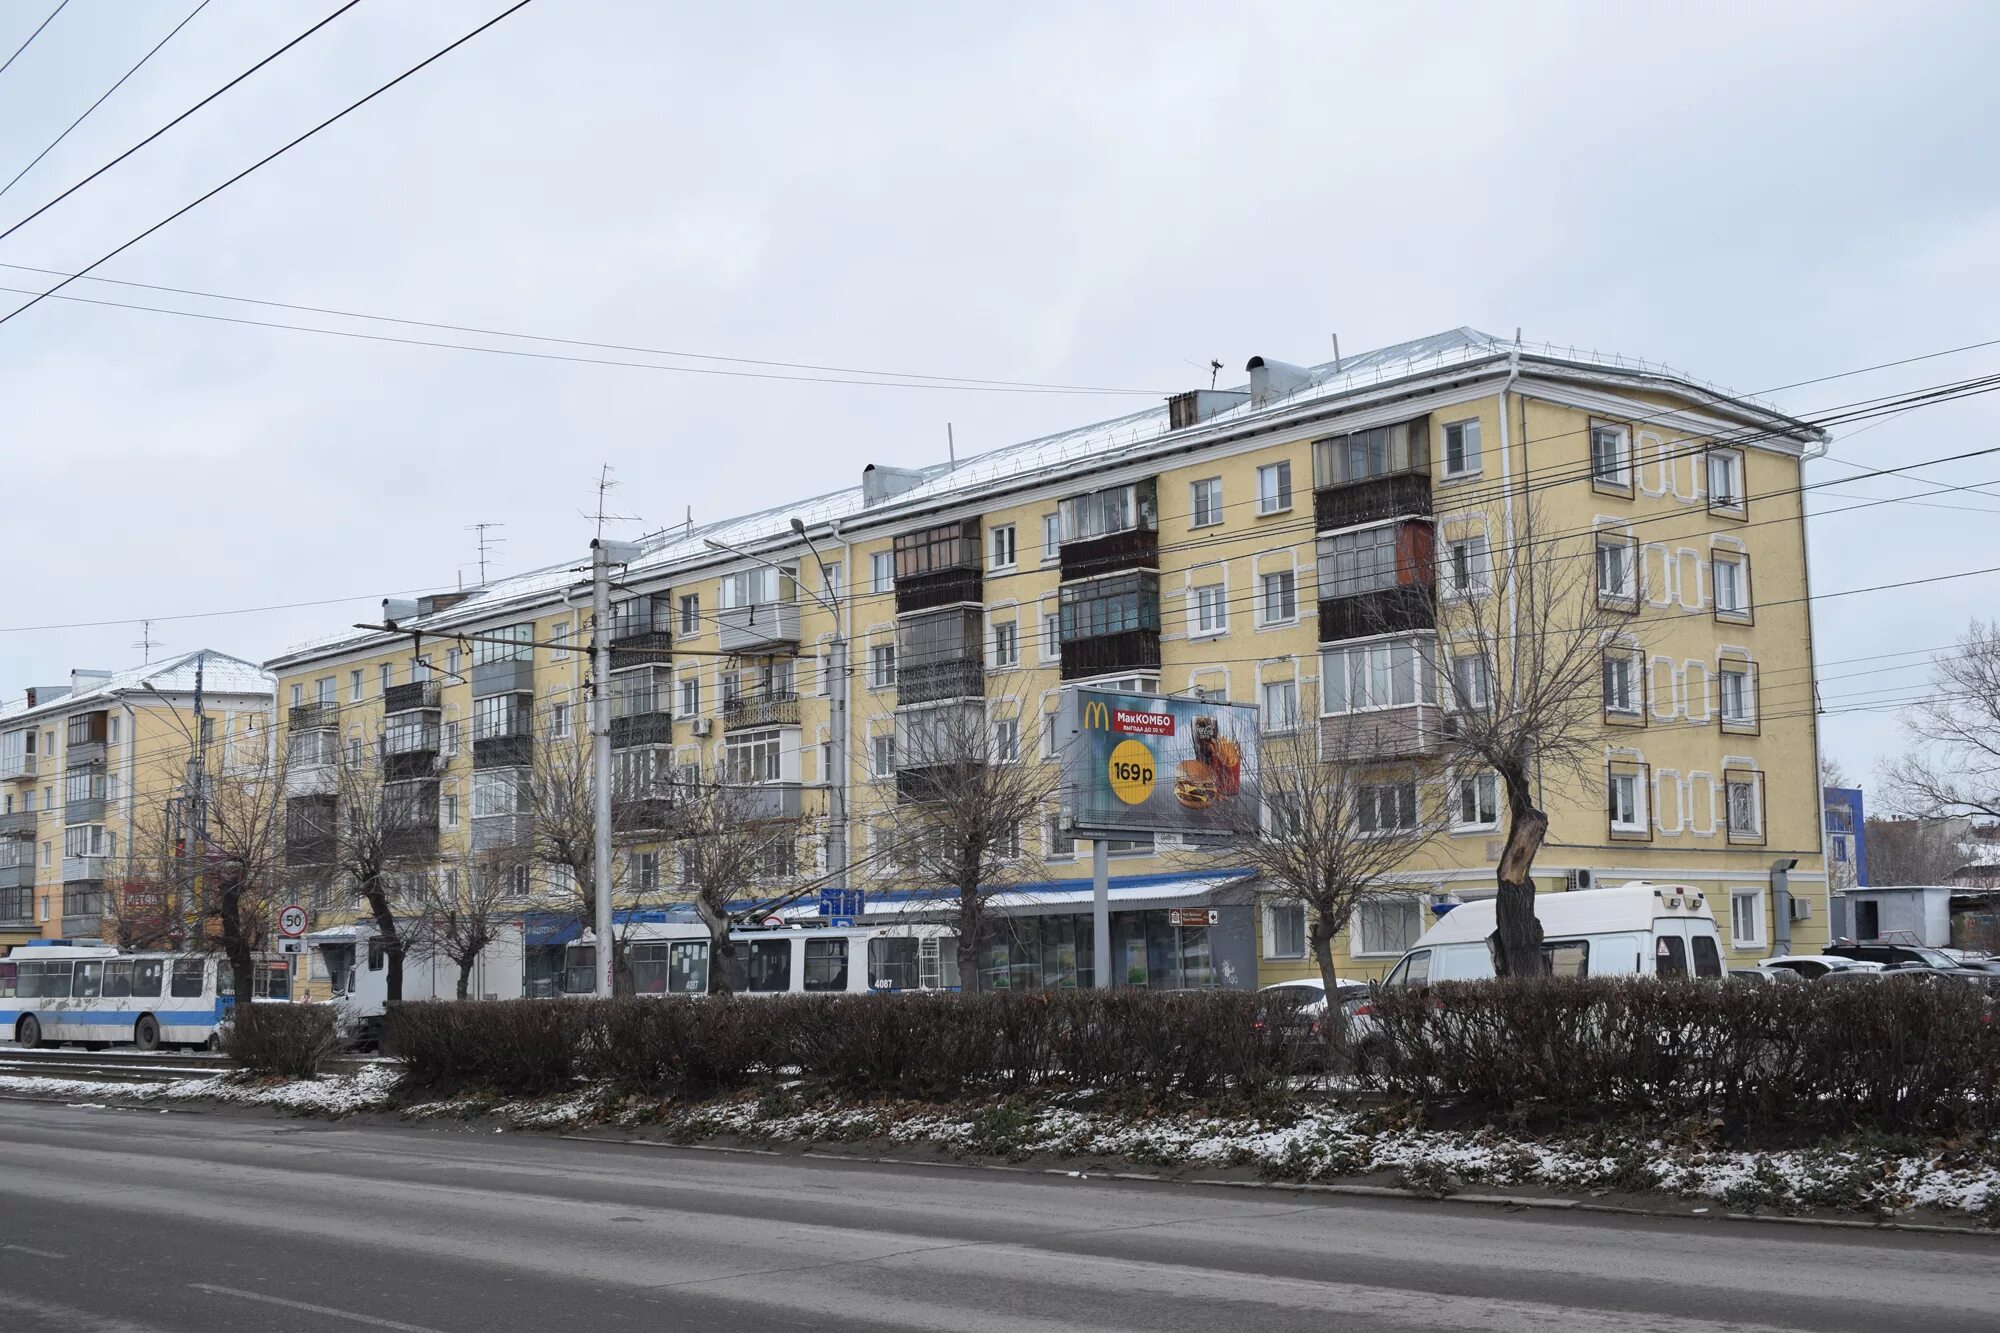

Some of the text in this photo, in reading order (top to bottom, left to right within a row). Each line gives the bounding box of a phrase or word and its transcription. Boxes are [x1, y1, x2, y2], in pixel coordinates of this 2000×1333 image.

[1117, 712, 1170, 726] МакКОМБО
[287, 915, 302, 927] 50
[874, 979, 893, 988] 4087
